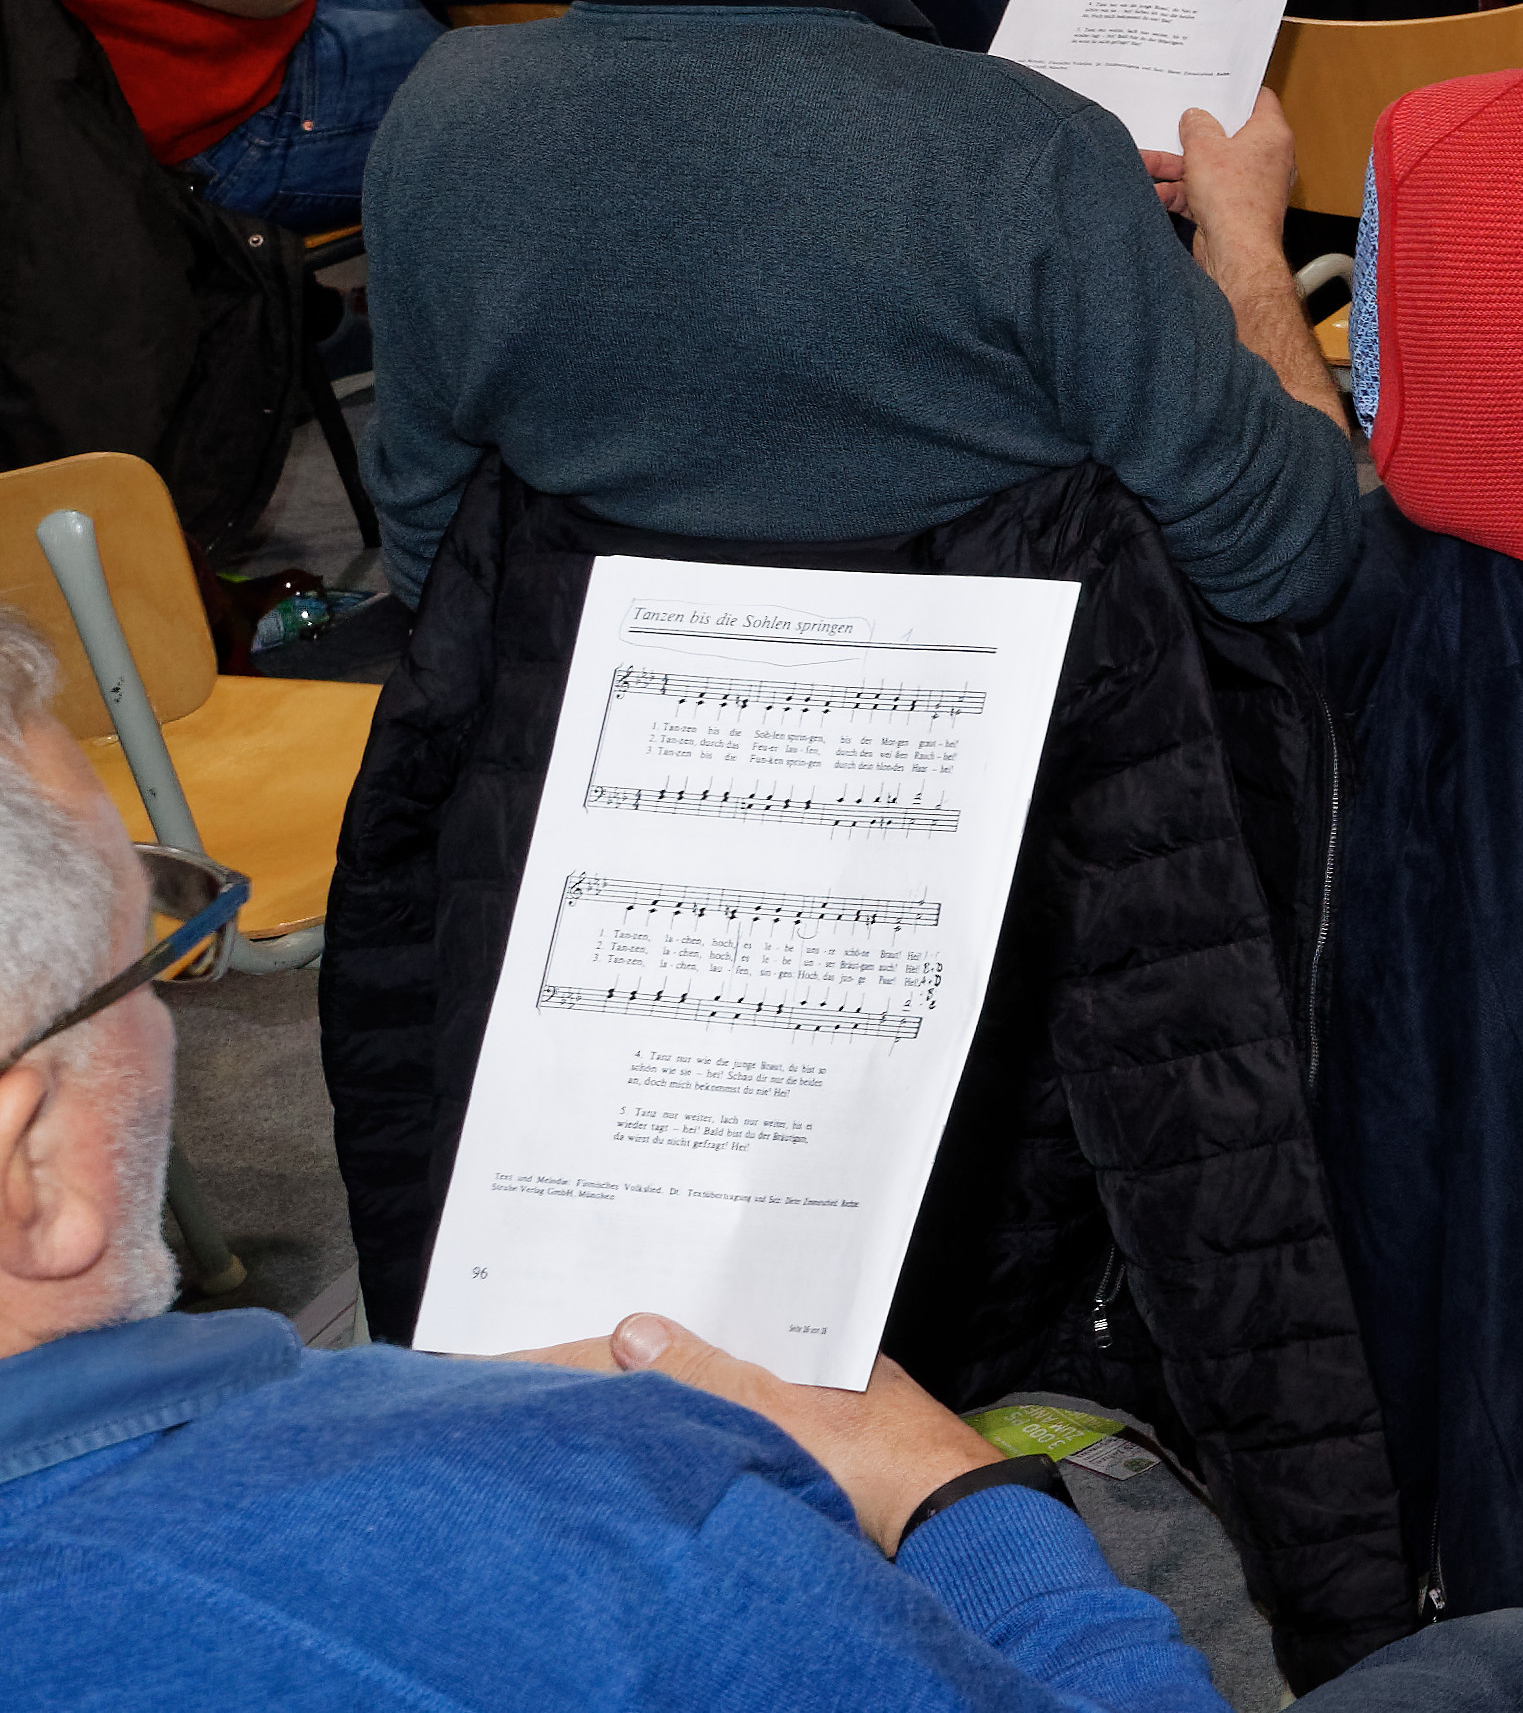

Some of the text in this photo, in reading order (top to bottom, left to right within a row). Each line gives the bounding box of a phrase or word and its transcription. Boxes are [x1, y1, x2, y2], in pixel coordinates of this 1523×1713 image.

[634, 608, 853, 636] Tanzen bis die Sohlen springen
[716, 1058, 728, 1066] die
[644, 1077, 666, 1087] doch
[669, 1081, 691, 1089] mich
[617, 1121, 646, 1129] wieder
[703, 1127, 723, 1136] Bald
[667, 1138, 689, 1147] nicht
[471, 1266, 488, 1280] 96
